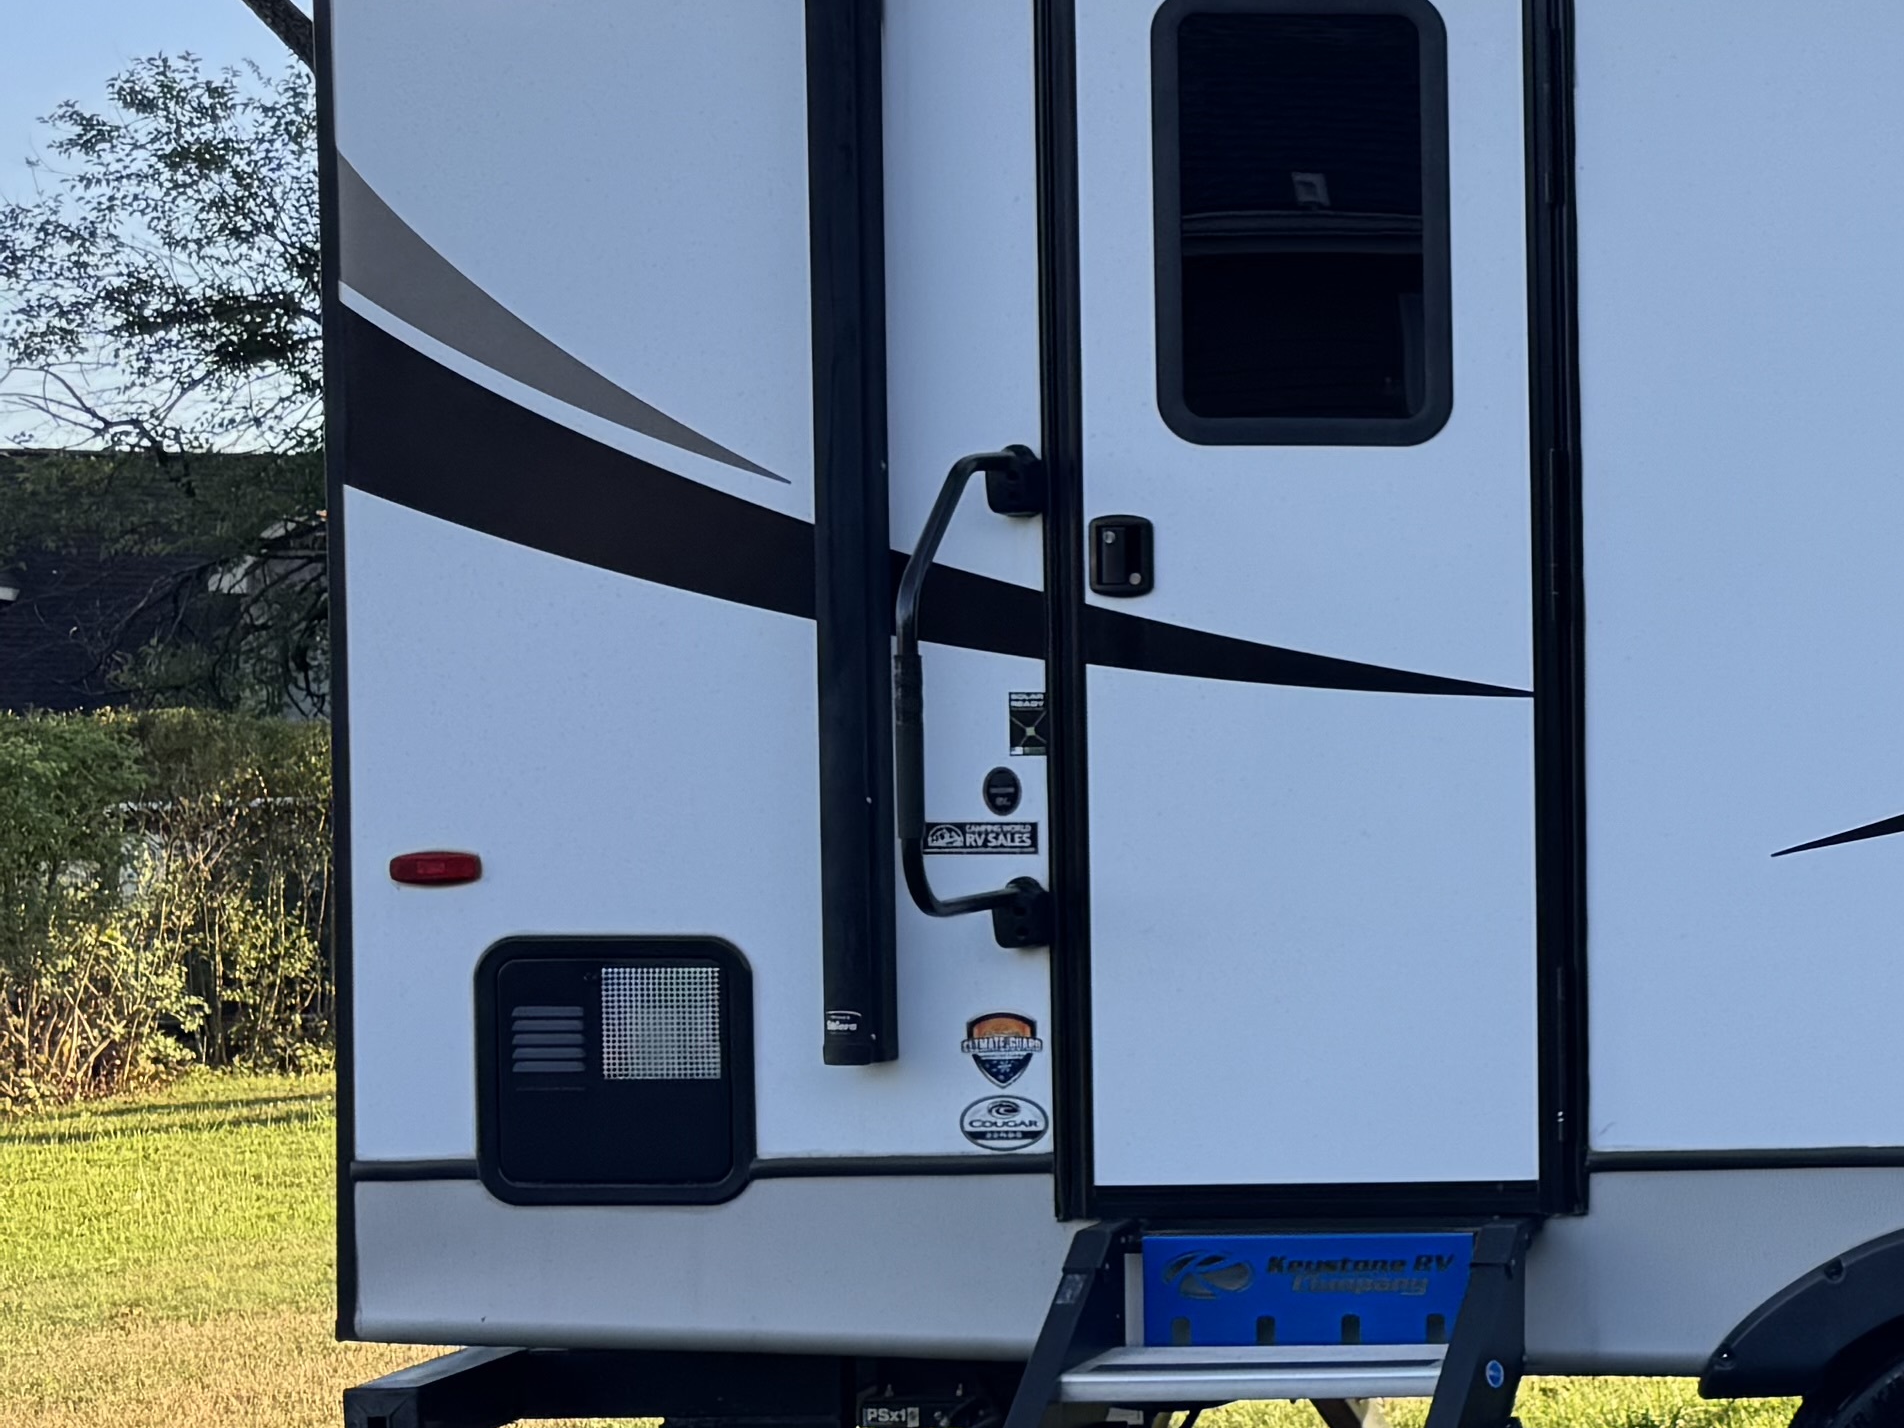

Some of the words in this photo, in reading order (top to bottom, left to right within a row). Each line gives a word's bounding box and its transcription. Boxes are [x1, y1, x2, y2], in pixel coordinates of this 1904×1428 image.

[1003, 824, 1032, 832] WORLD
[965, 833, 986, 847] RV
[987, 833, 1032, 847] SALES
[963, 1036, 1005, 1052] CLIMATE
[1009, 1036, 1041, 1051] GUARD
[968, 1119, 1038, 1128] COUGAR
[1266, 1255, 1406, 1274] Keystone
[1413, 1254, 1455, 1272] RV
